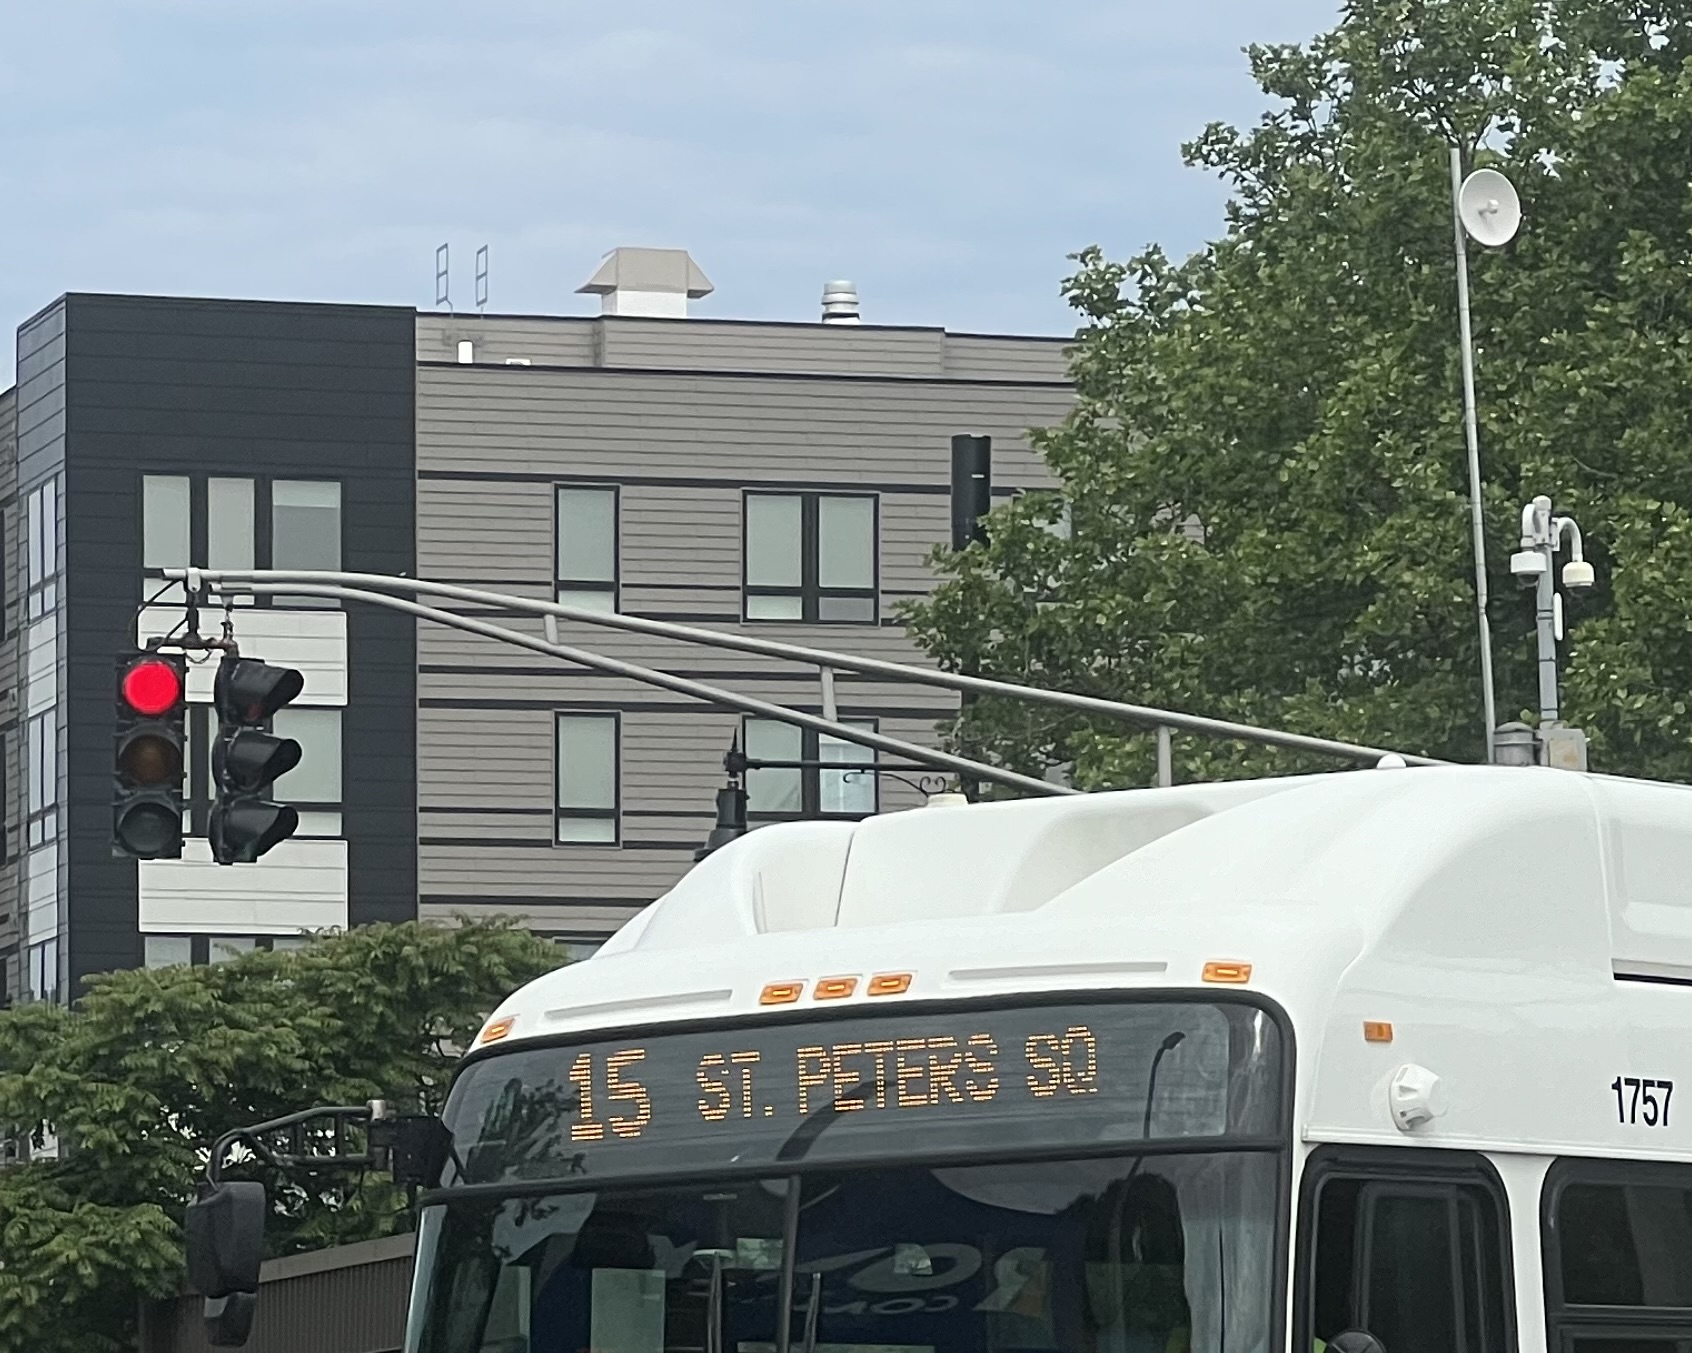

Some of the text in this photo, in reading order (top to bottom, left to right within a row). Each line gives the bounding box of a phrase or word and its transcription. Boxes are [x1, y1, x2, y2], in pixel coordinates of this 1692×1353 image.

[569, 1025, 1098, 1141] 15 ST. PETERS SQ
[1611, 1076, 1674, 1126] 1757
